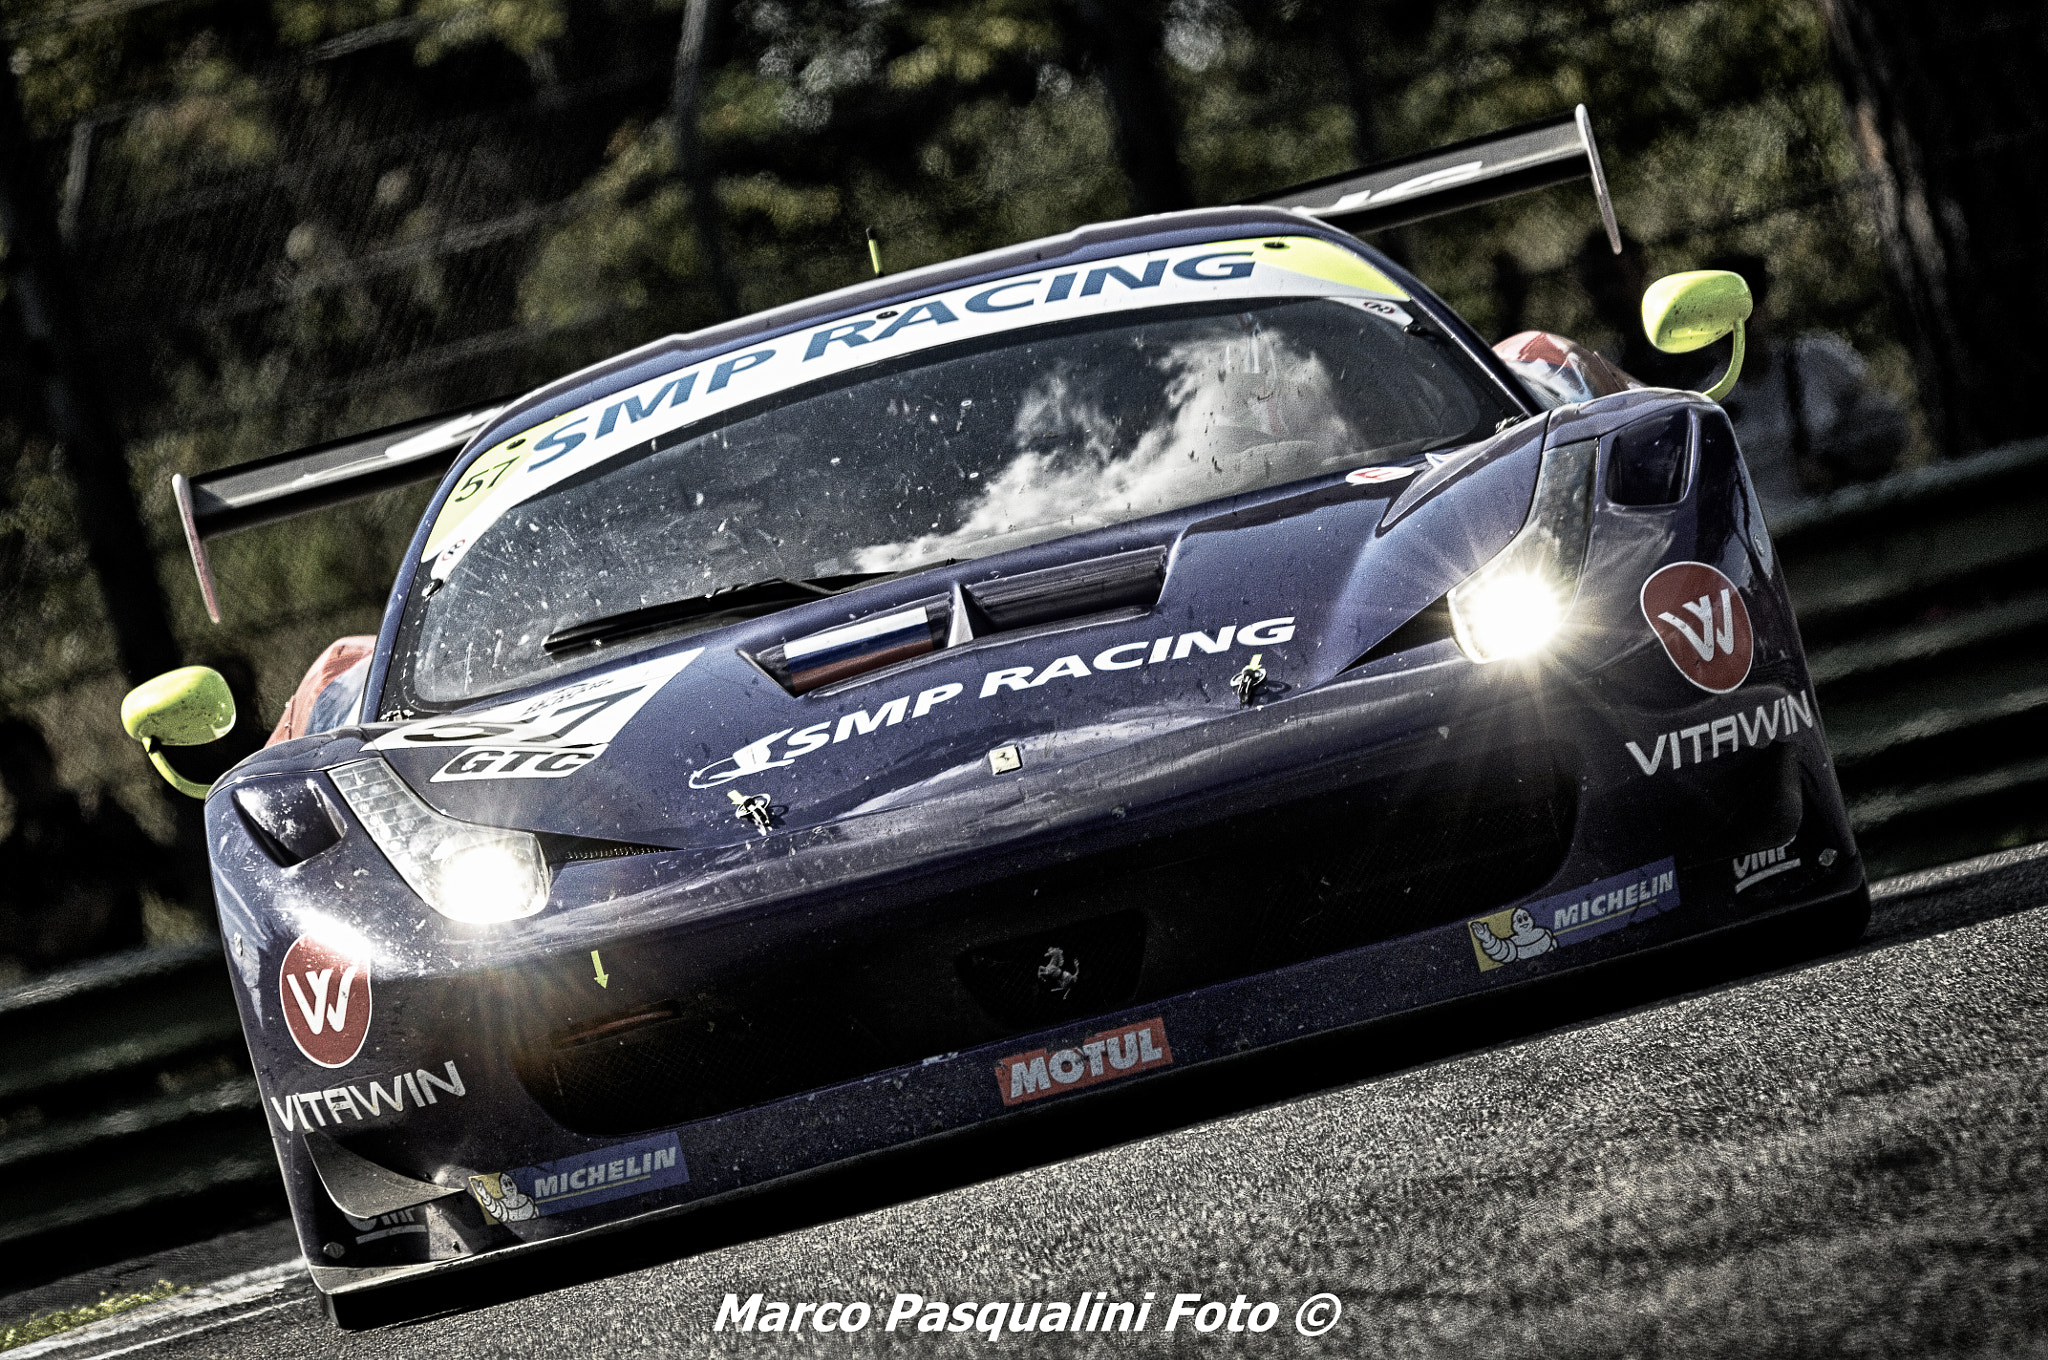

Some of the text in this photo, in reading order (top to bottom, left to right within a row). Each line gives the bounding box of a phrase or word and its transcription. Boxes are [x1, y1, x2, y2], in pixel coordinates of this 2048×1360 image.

[527, 348, 777, 473] SMP
[803, 246, 1256, 363] RACING
[455, 456, 520, 503] 57
[403, 684, 648, 743] 57
[782, 616, 1296, 761] SMP RACING
[444, 749, 598, 775] GTC
[1625, 690, 1814, 777] VITAWIN
[1553, 870, 1675, 931] MICHELIN
[1010, 1028, 1163, 1098] MOTUL
[270, 1060, 467, 1132] VITAWIN
[534, 1147, 676, 1199] MICHELIN
